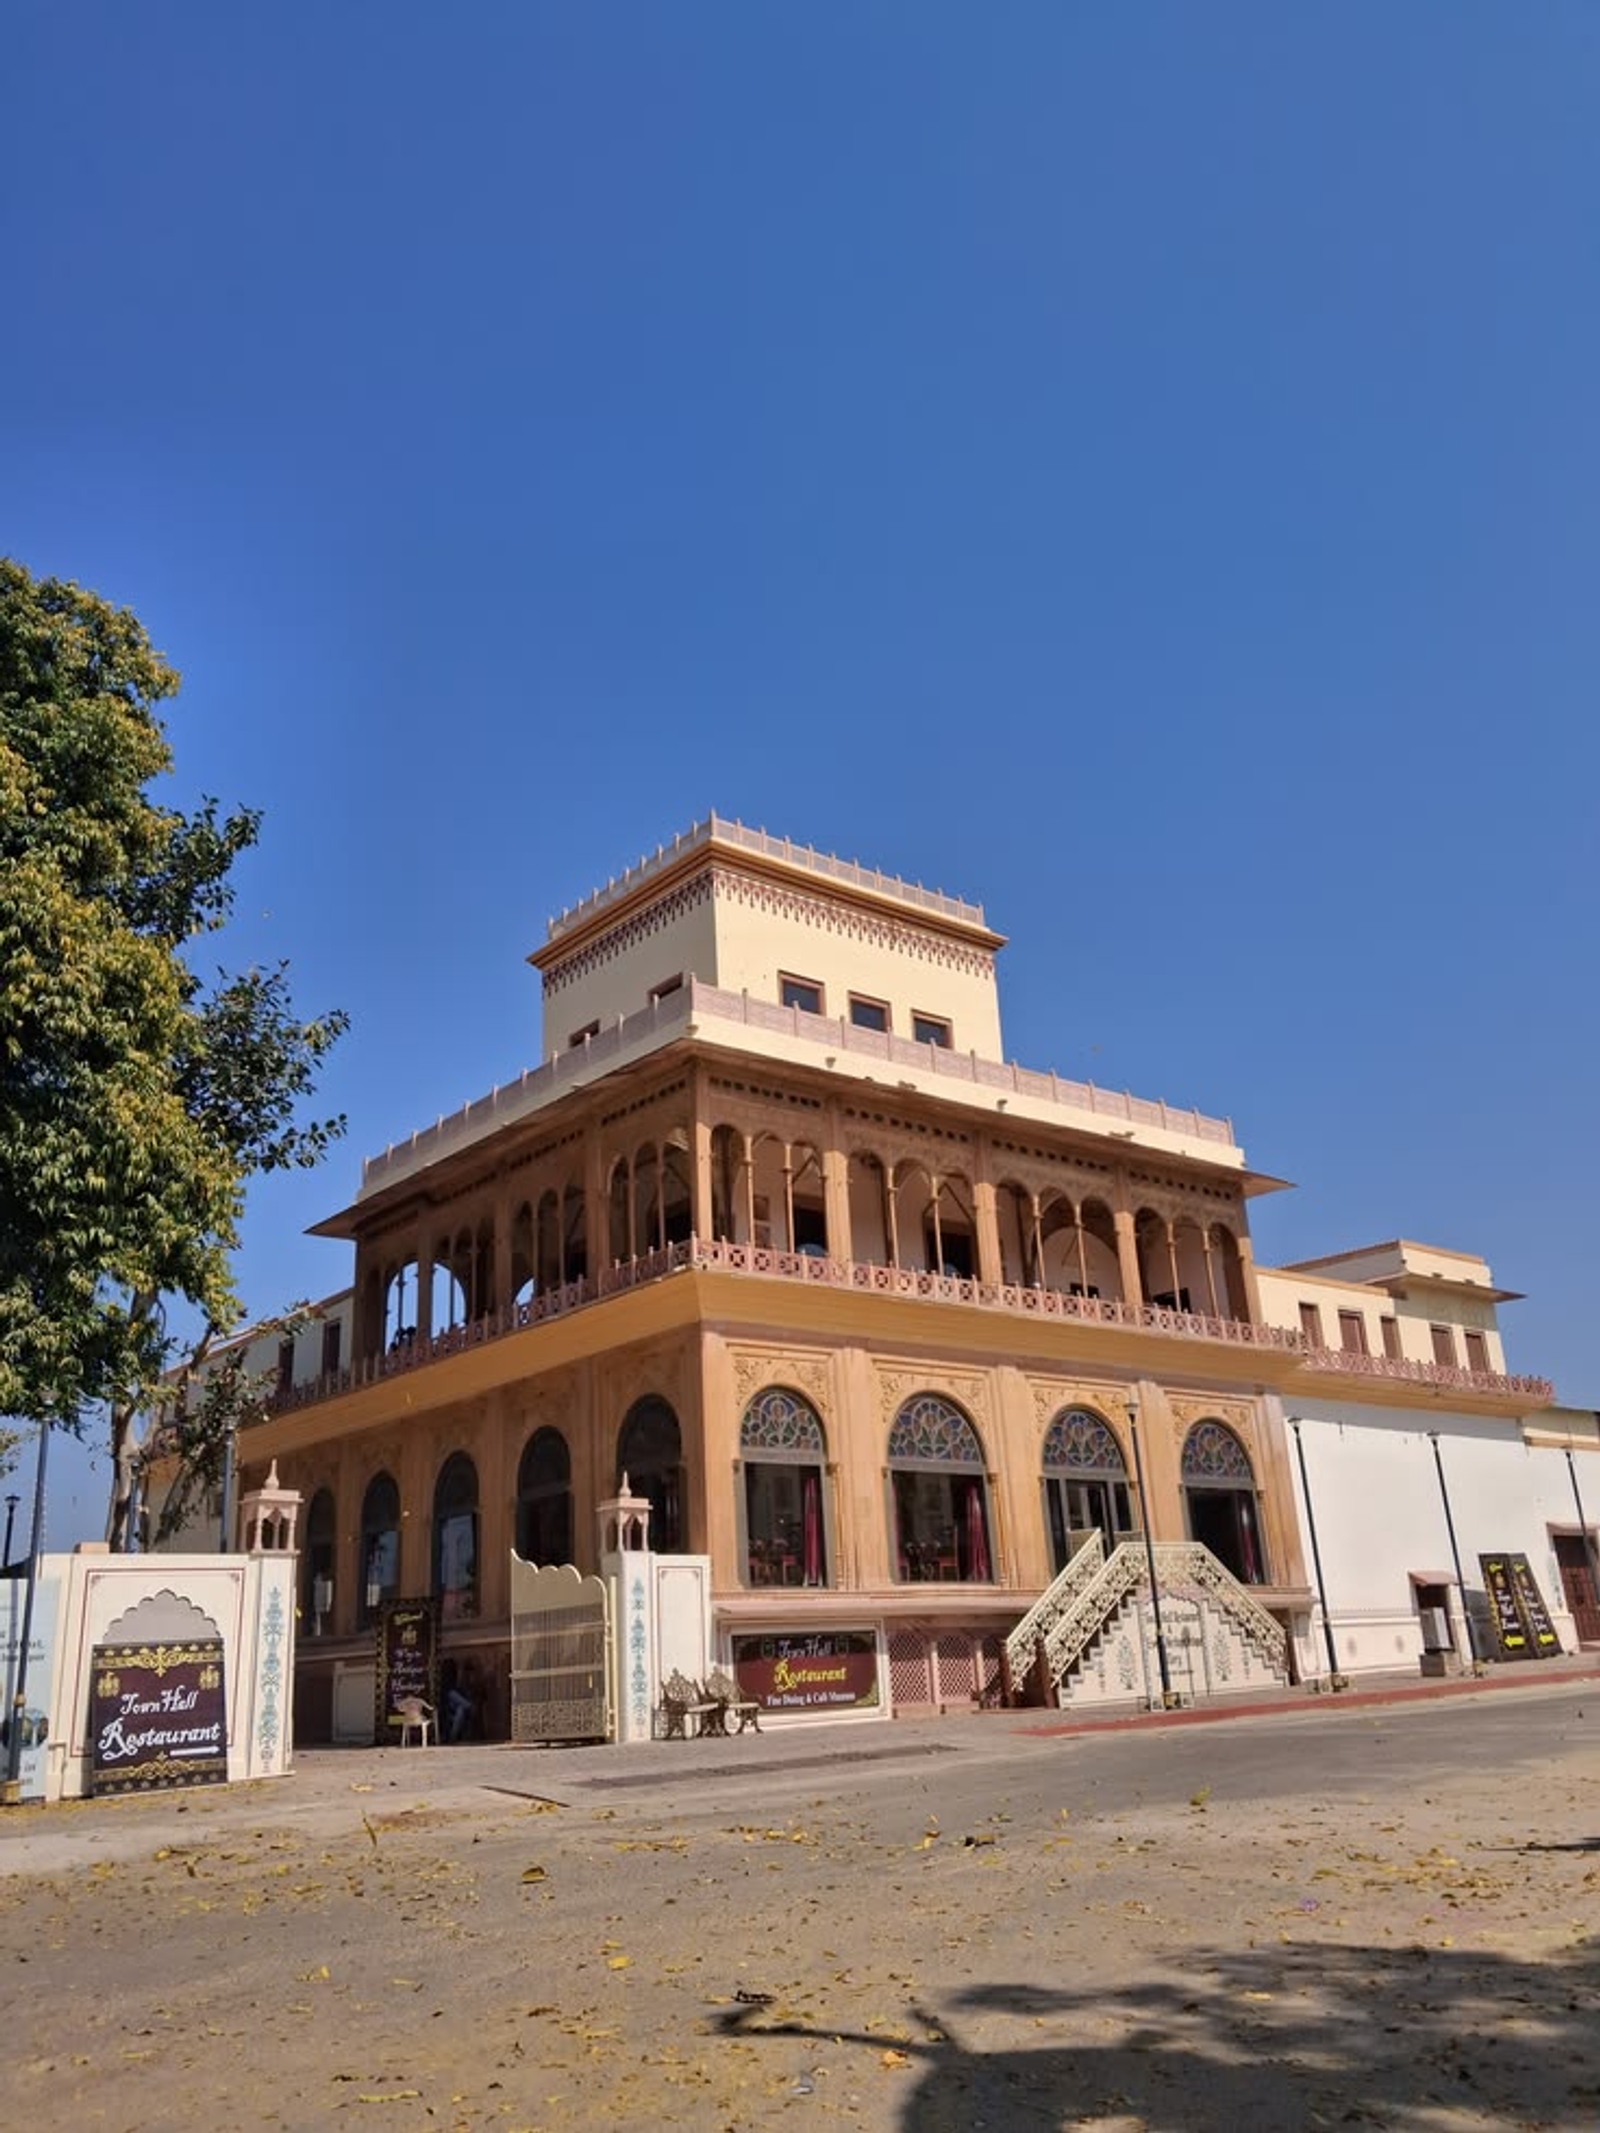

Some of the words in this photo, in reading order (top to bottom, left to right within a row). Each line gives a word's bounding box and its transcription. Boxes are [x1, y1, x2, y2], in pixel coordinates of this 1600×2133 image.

[774, 1658, 846, 1692] Restaurant
[120, 1693, 160, 1714] Town
[160, 1685, 199, 1712] Hall
[98, 1717, 220, 1760] Restaurant
